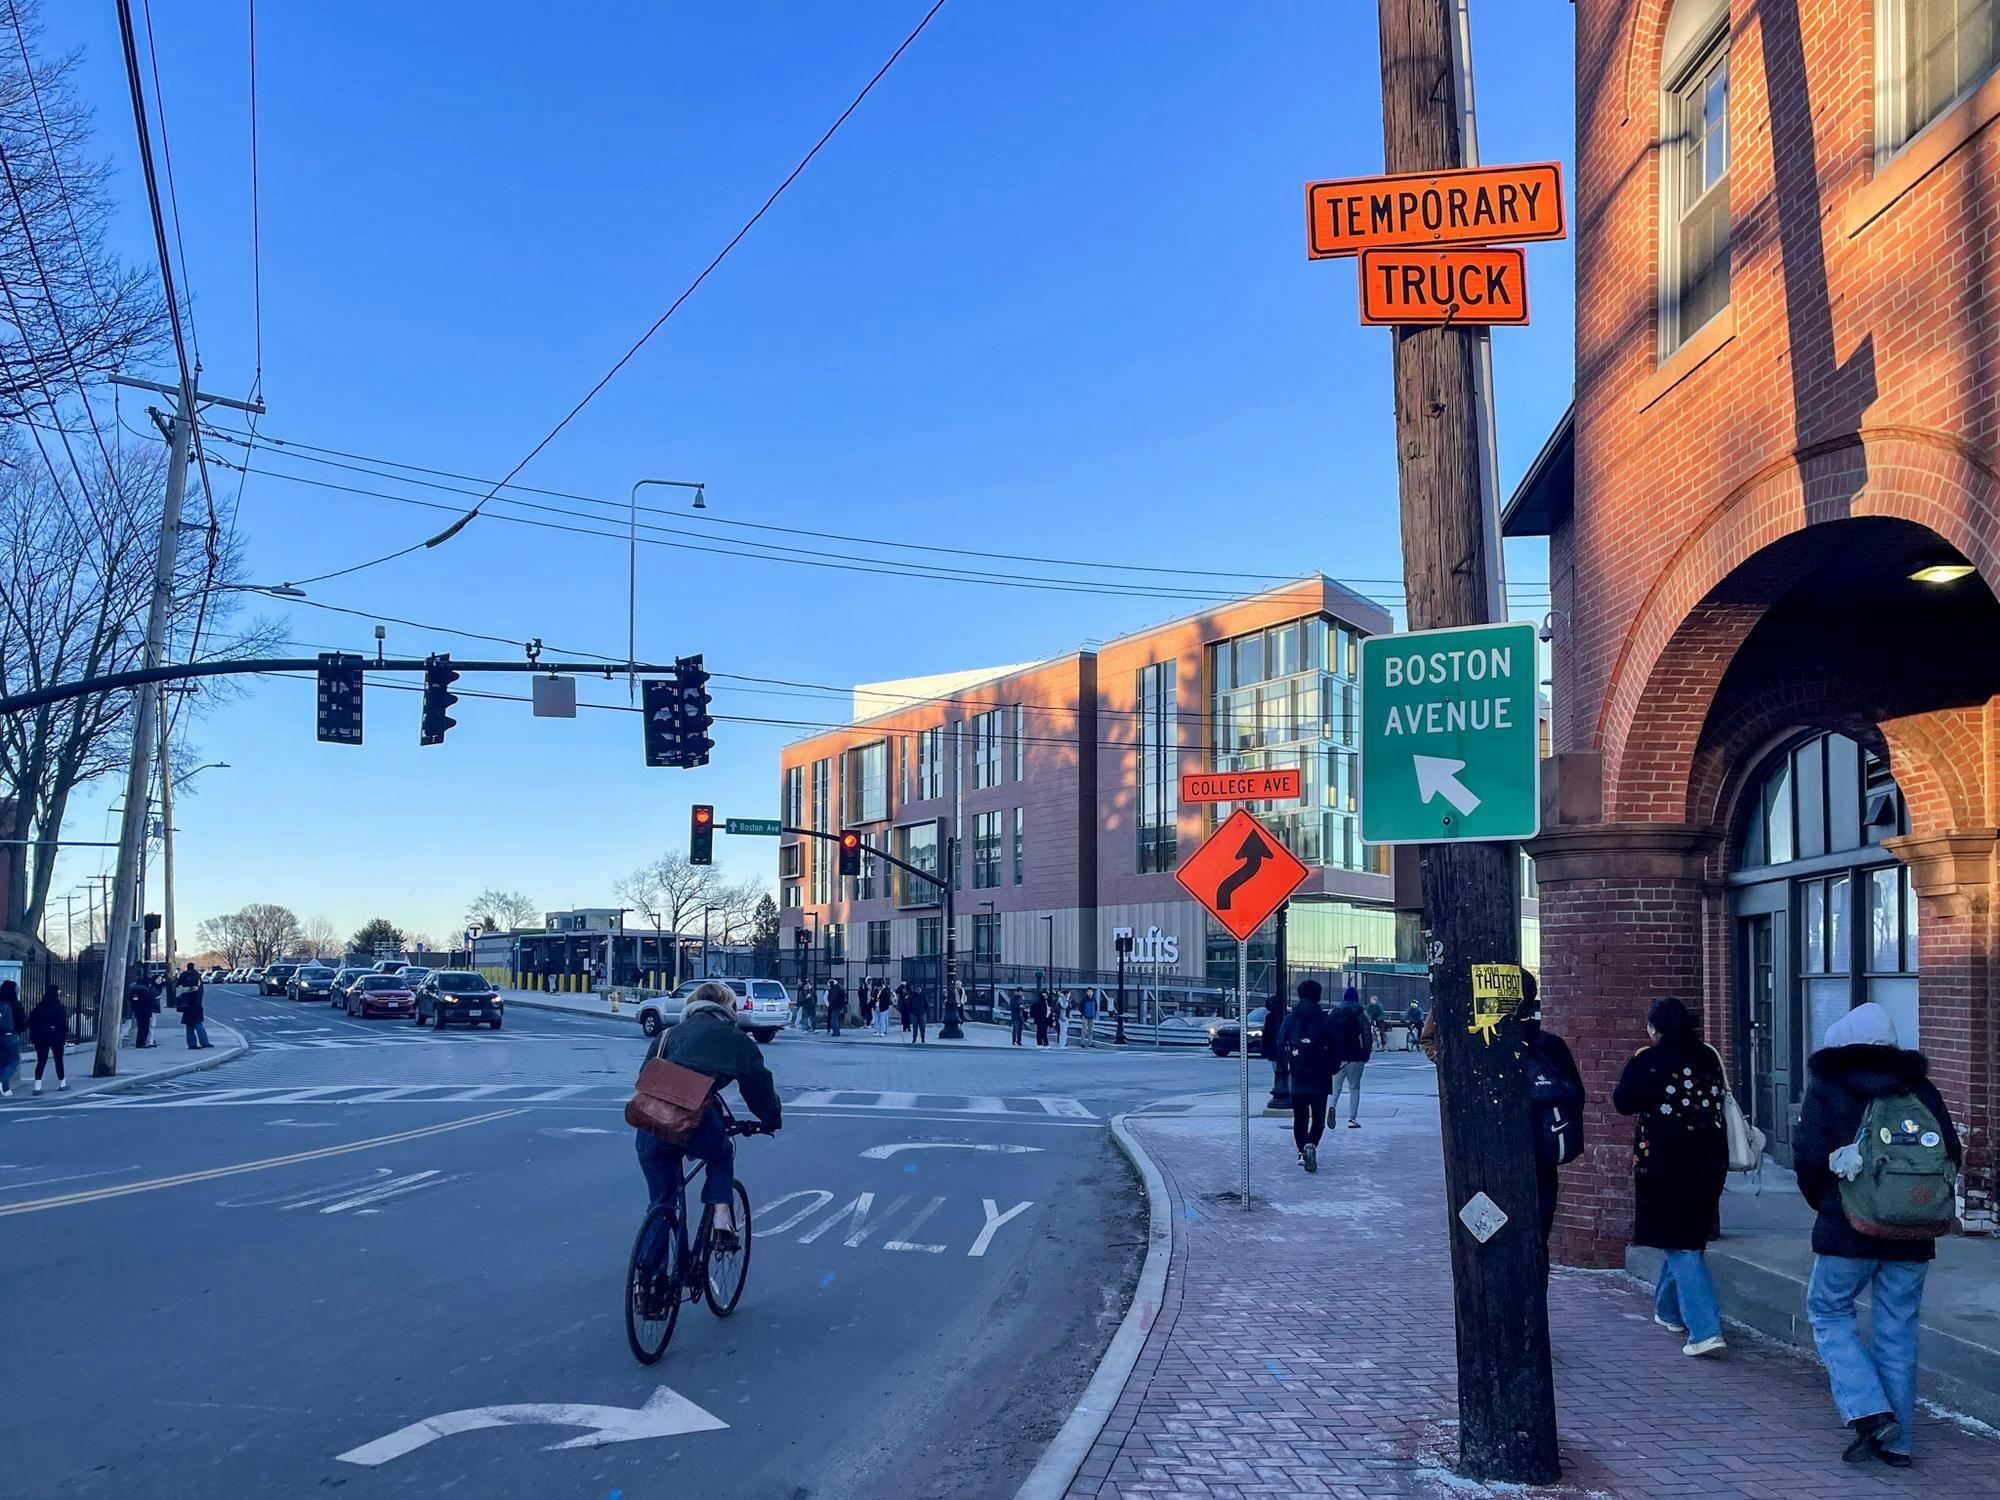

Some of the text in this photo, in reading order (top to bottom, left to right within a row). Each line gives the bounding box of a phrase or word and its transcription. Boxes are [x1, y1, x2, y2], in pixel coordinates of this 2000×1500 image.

[1326, 182, 1542, 238] TEMPORARY
[1377, 265, 1511, 305] TRUCK
[1385, 647, 1511, 687] BOSTON
[1384, 697, 1512, 736] AVENUE
[1191, 777, 1291, 796] COLLEGE AVE
[739, 822, 779, 832] Boston Ave
[469, 926, 481, 937] T
[1112, 926, 1180, 963] Tufts
[744, 1190, 1035, 1257] ONLY
